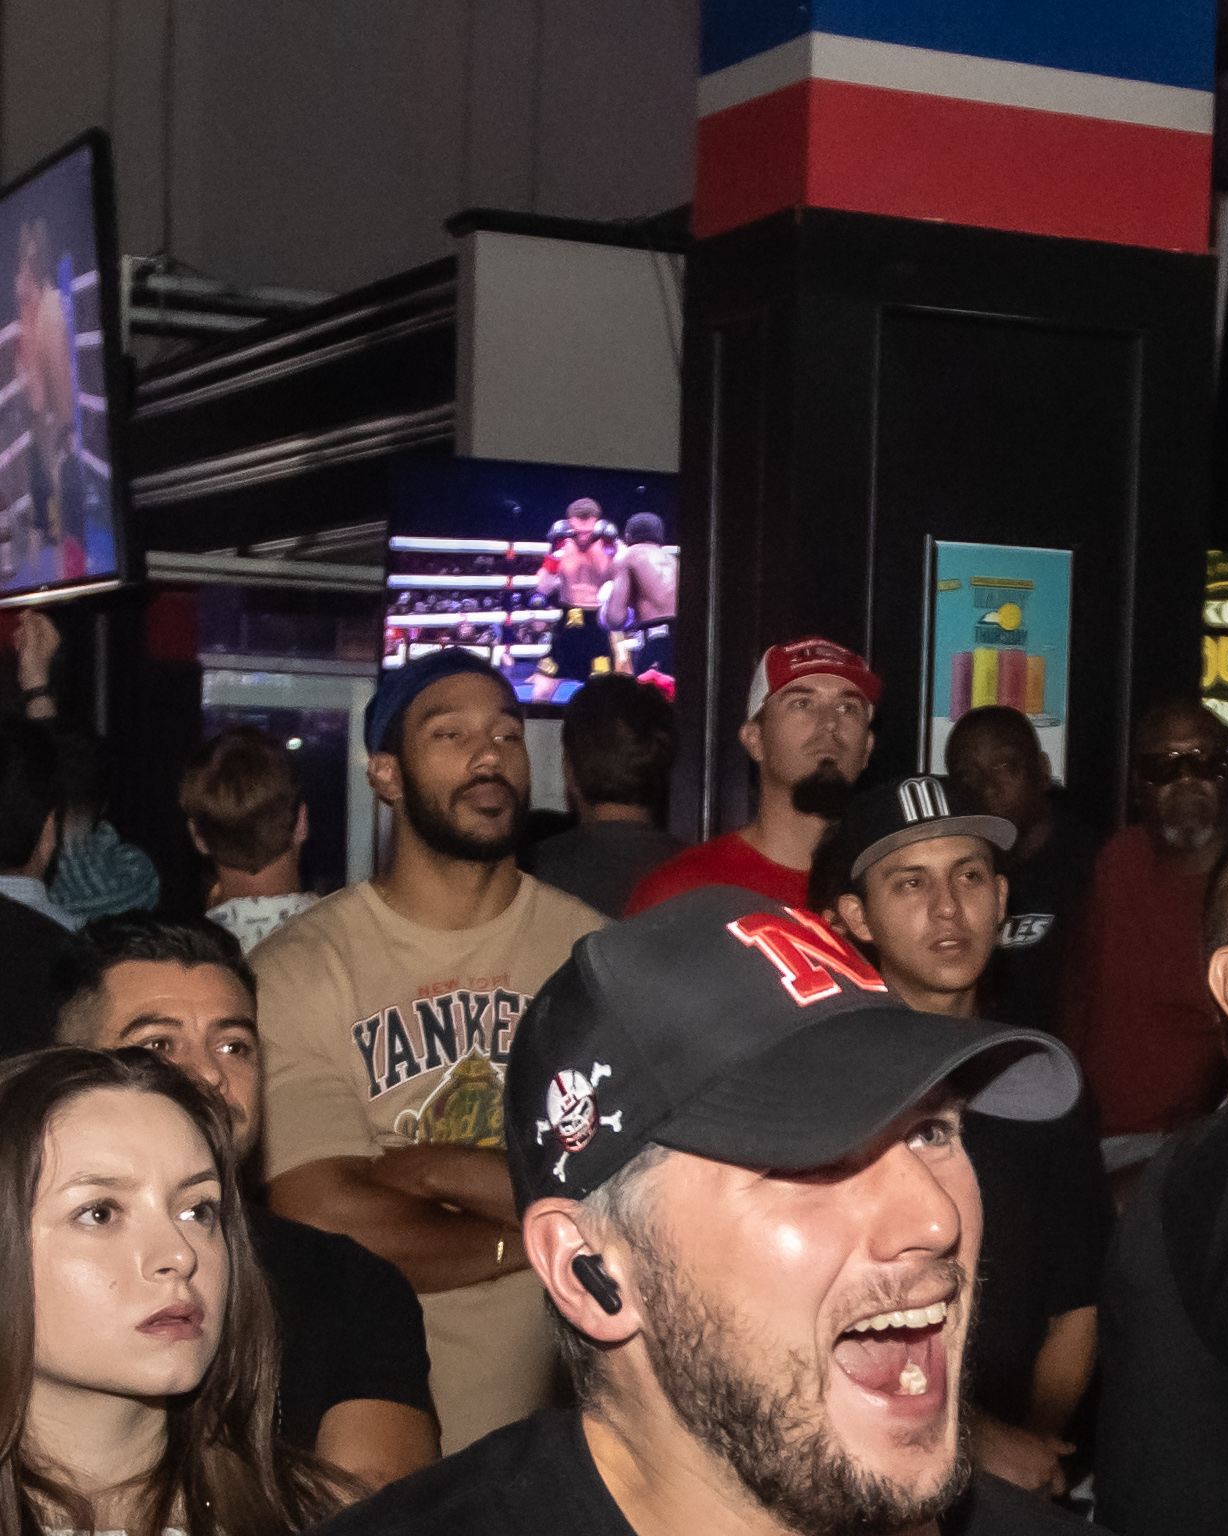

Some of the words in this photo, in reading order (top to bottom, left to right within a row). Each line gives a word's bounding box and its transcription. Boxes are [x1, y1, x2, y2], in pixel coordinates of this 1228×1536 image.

[726, 905, 888, 1007] N
[1002, 914, 1052, 947] LES
[351, 986, 534, 1102] YANKE
